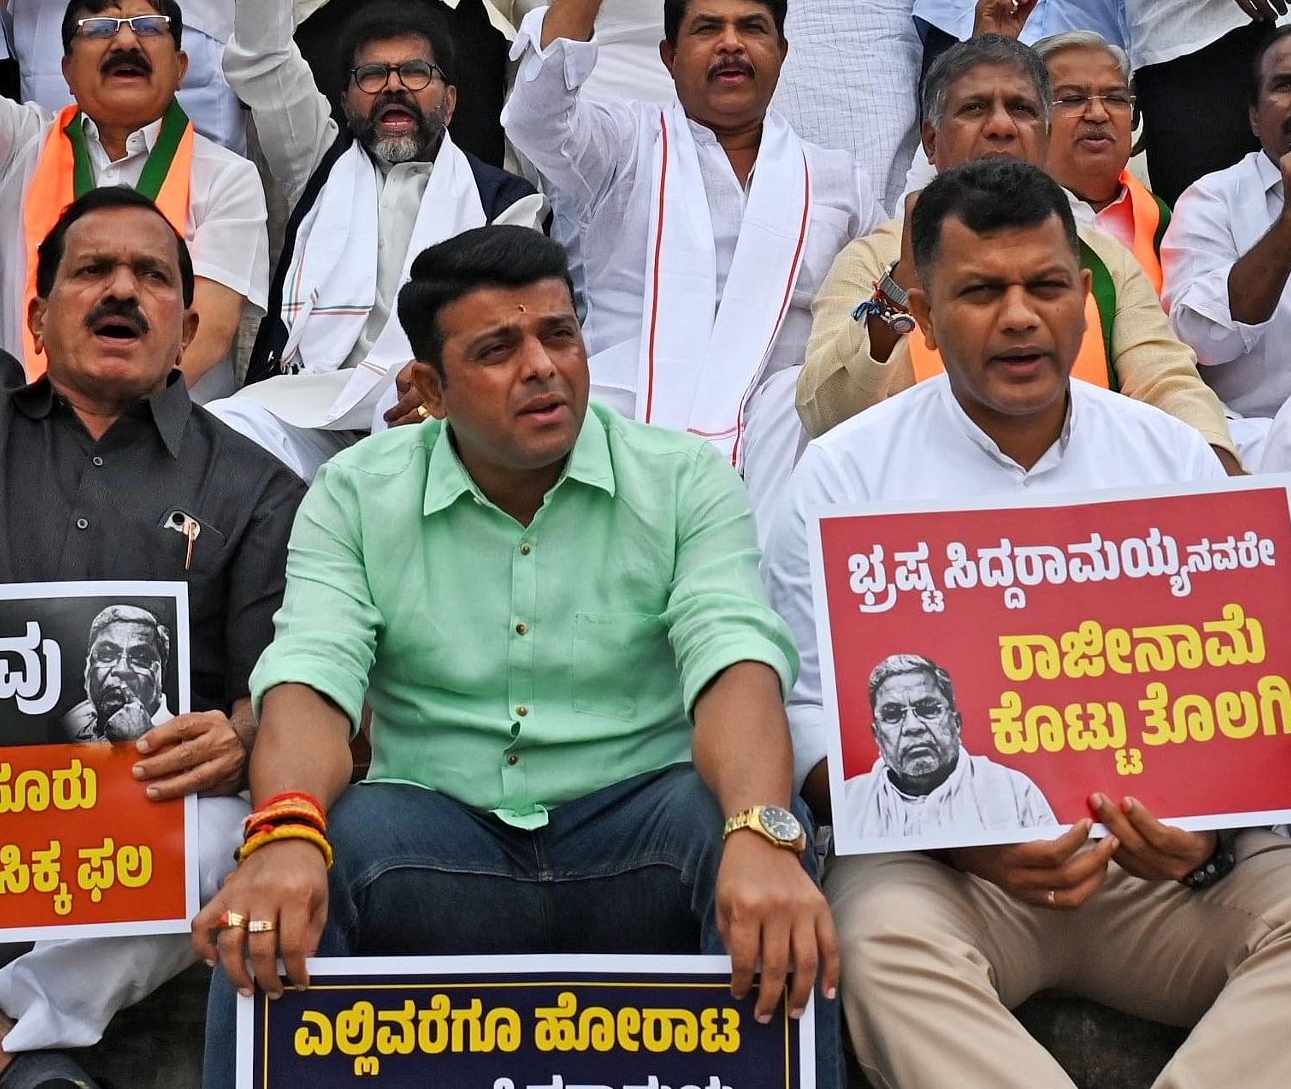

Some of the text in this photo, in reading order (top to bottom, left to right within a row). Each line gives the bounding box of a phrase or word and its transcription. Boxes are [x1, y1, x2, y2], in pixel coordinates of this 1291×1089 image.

[847, 542, 946, 613] ಭ್ರಷ್ಟ
[998, 603, 1266, 683] ರಾಜೀನಾಮೆ
[988, 690, 1144, 776] ಕೊಟ್ಟು
[78, 837, 153, 904] ಫಲ
[294, 991, 741, 1076] ಎಲ್ಲಿವರೆಗೂ ಹೋರಾಟ
